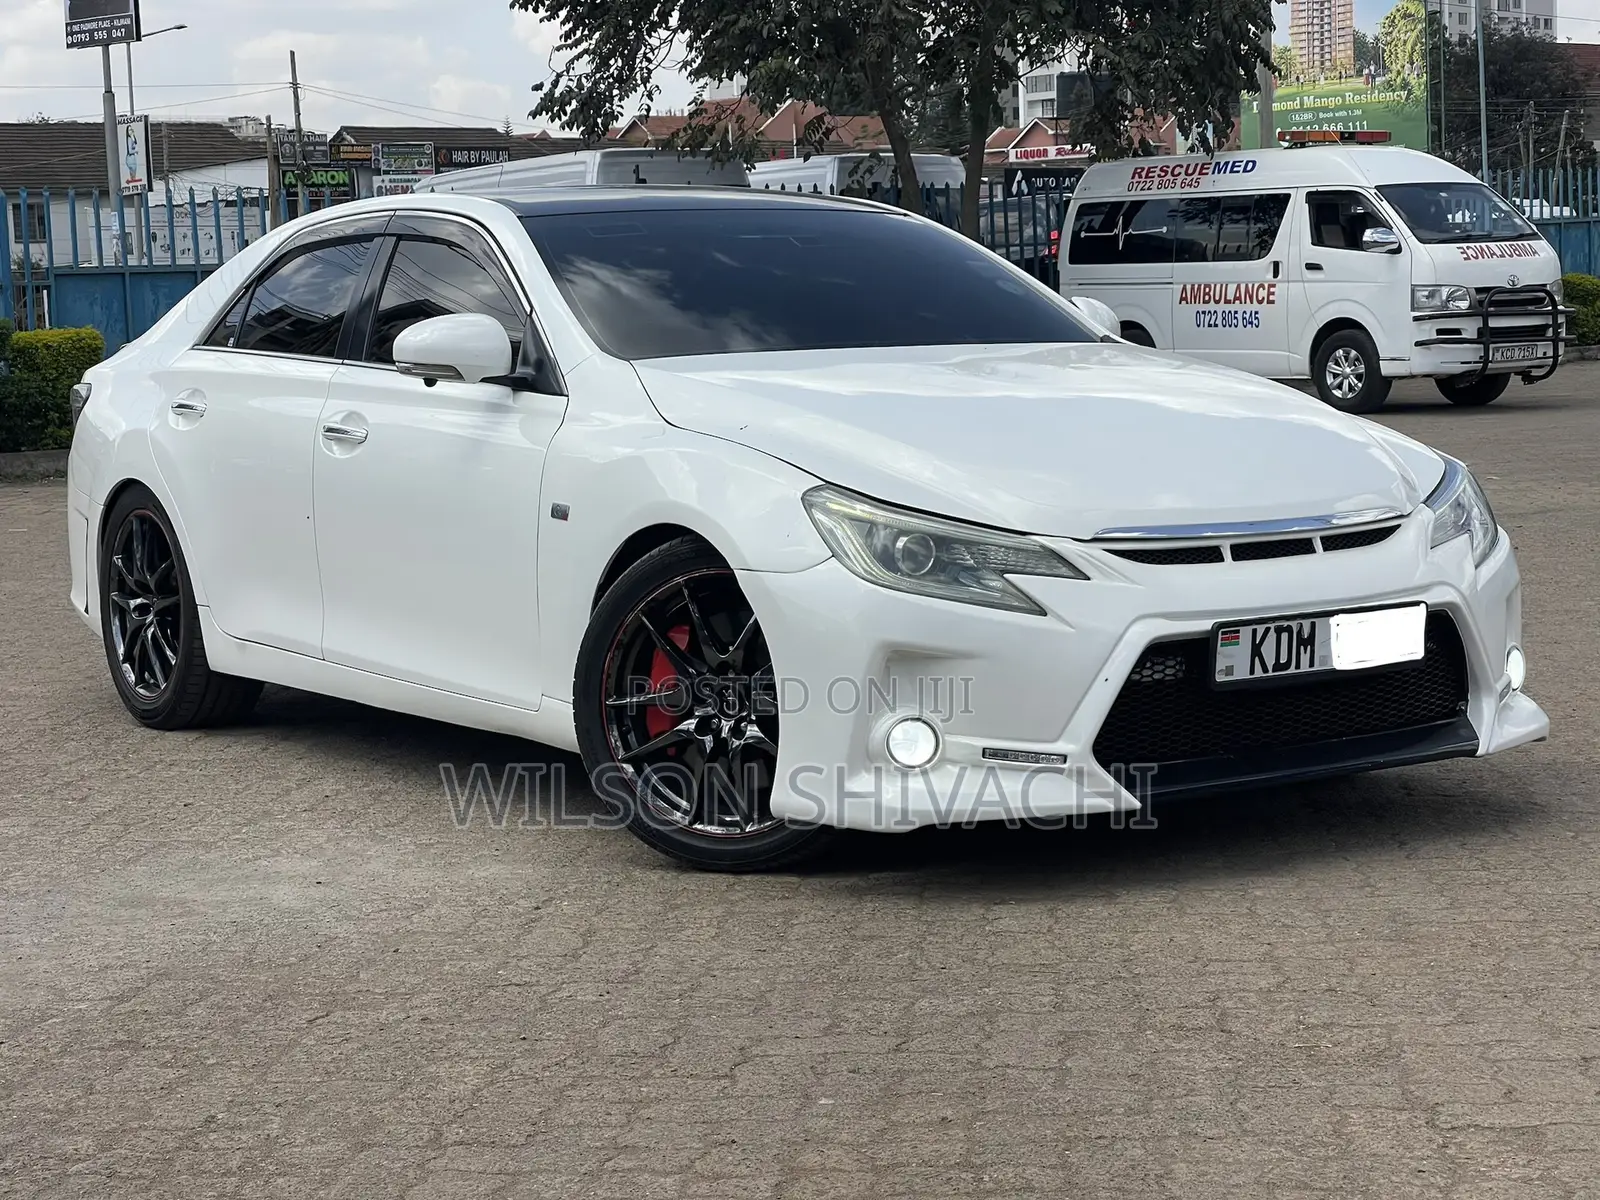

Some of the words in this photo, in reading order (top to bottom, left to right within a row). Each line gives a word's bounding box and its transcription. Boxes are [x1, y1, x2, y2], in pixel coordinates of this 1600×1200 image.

[98, 20, 111, 28] PLACE
[72, 33, 90, 42] 0793
[94, 30, 108, 40] 555
[1252, 96, 1300, 113] Dmond
[1303, 95, 1342, 109] Mango
[1345, 90, 1408, 104] Residency
[117, 115, 143, 125] MASSAGE
[1319, 111, 1333, 119] Book
[452, 150, 469, 163] HAIR
[470, 150, 480, 163] BY
[481, 150, 508, 163] PAULAH
[1015, 148, 1048, 160] LIQUOR
[1131, 160, 1257, 180] RESCUEMED
[1127, 180, 1154, 192] 0722
[1157, 178, 1177, 190] 805
[1180, 177, 1201, 189] 645
[1179, 283, 1277, 305] AMBULANCE
[1195, 310, 1218, 328] 0722
[1221, 310, 1239, 328] 805
[1242, 310, 1260, 328] 645
[1249, 621, 1316, 676] KDM
